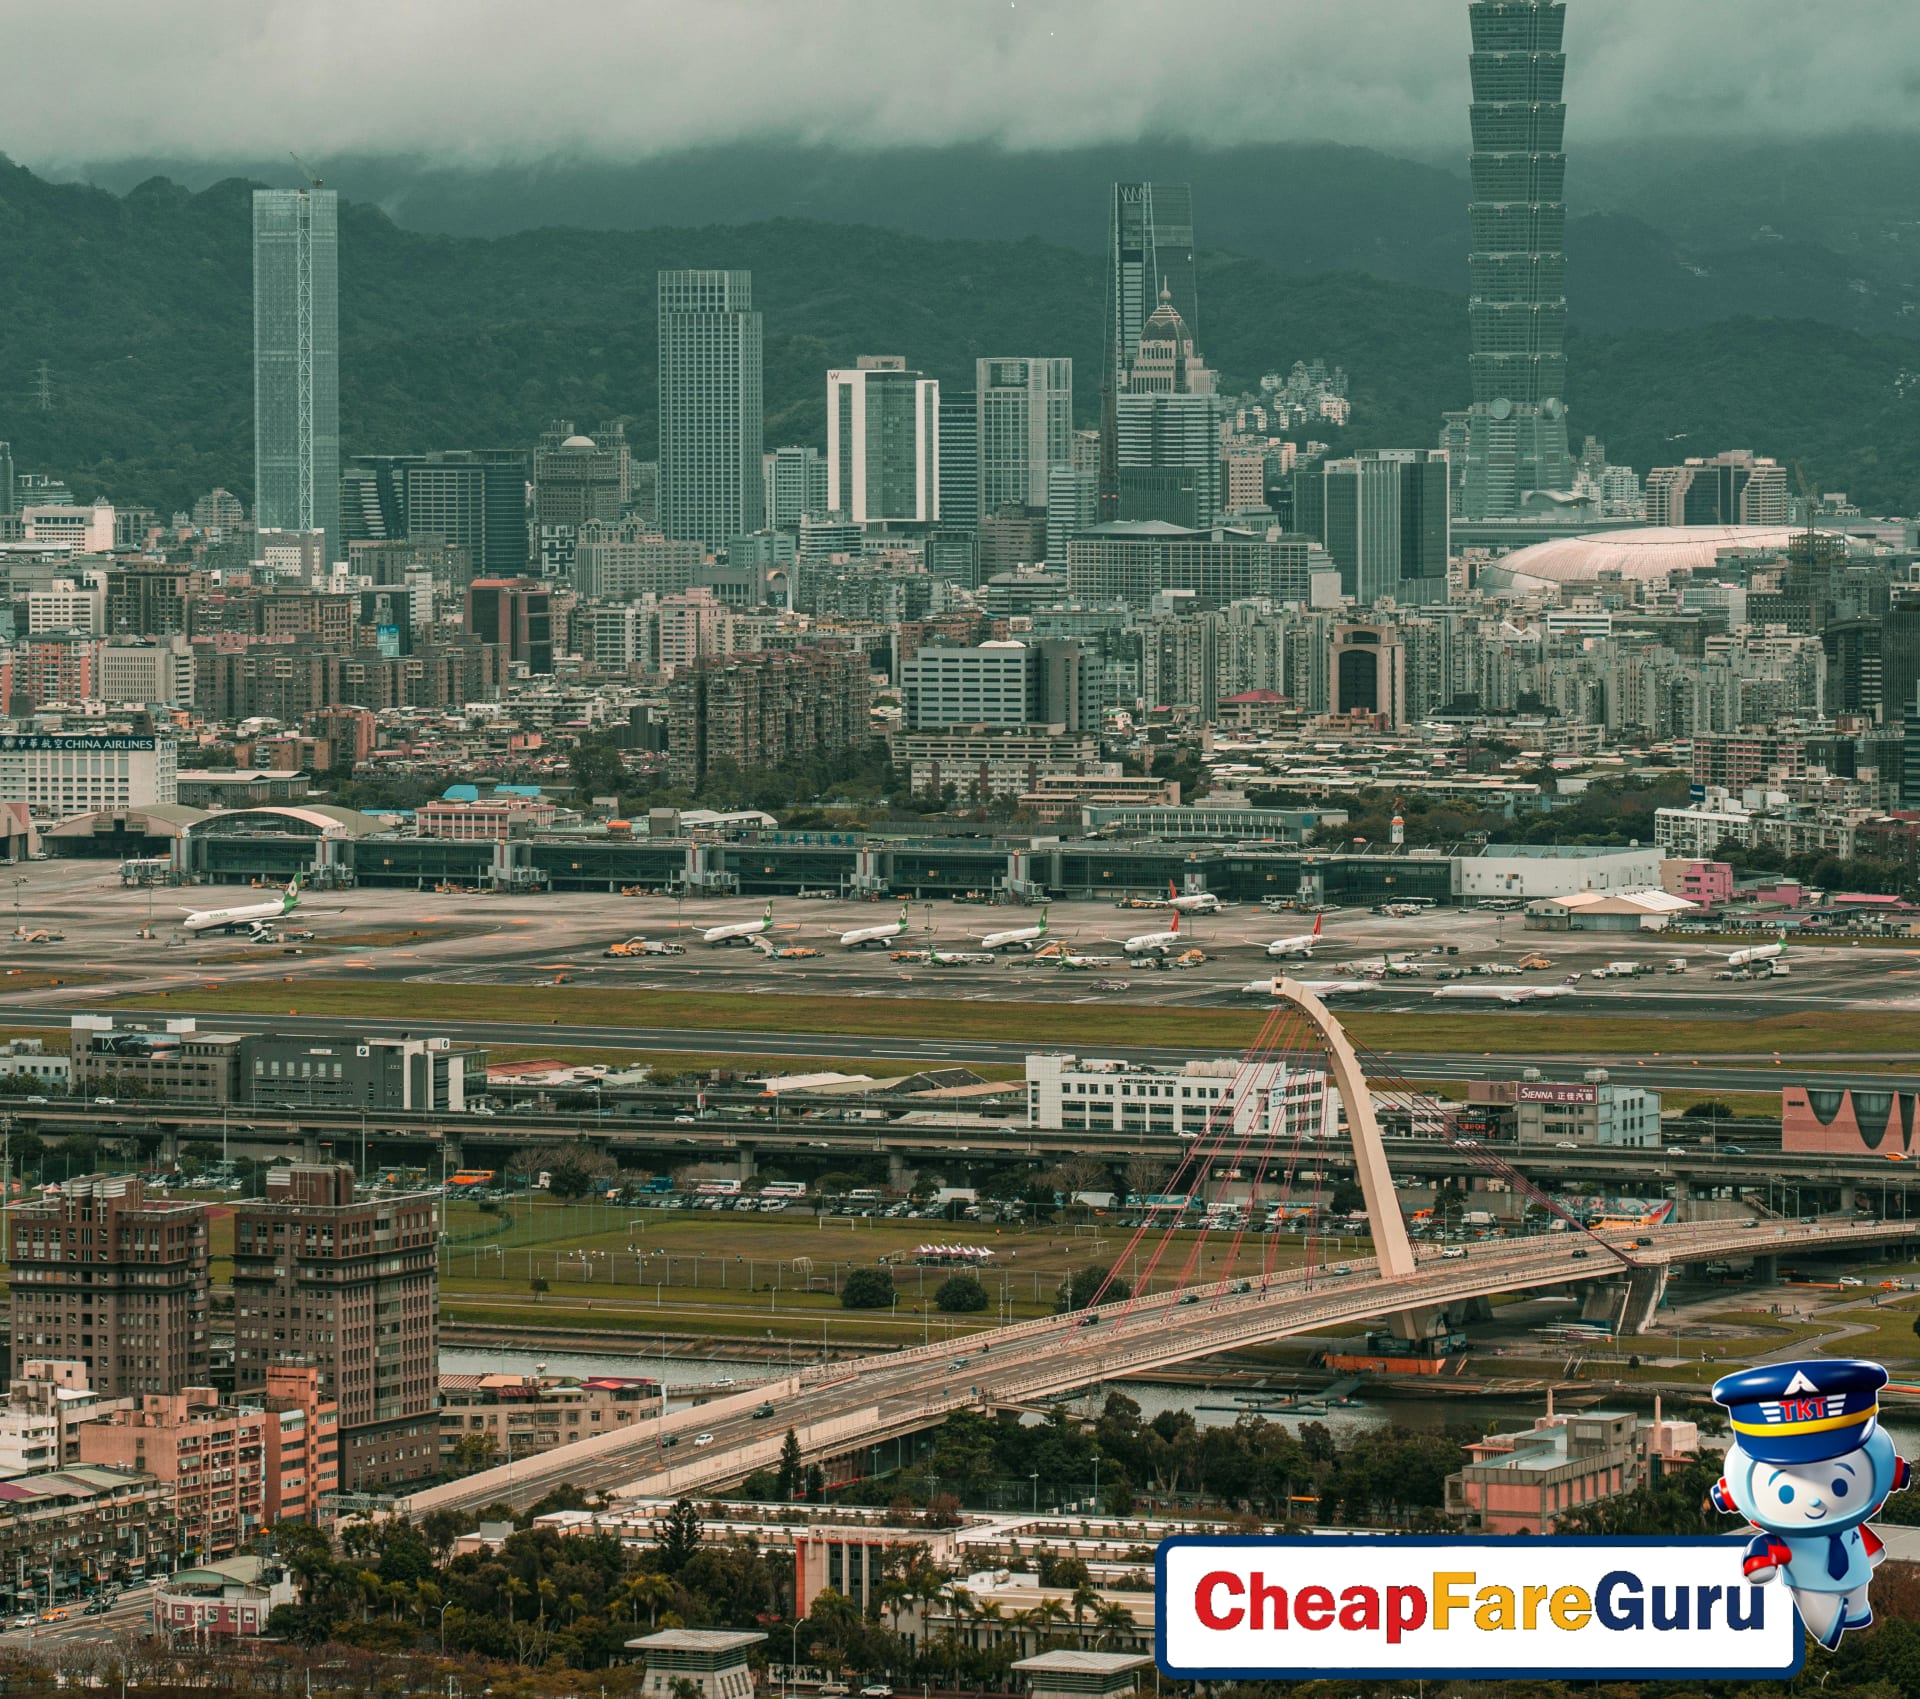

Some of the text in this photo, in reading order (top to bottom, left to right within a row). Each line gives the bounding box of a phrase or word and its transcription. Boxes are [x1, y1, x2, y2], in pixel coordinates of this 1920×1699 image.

[65, 739, 100, 749] CHINA
[103, 739, 153, 749] AIRLINES
[1521, 1087, 1553, 1099] SIENNA
